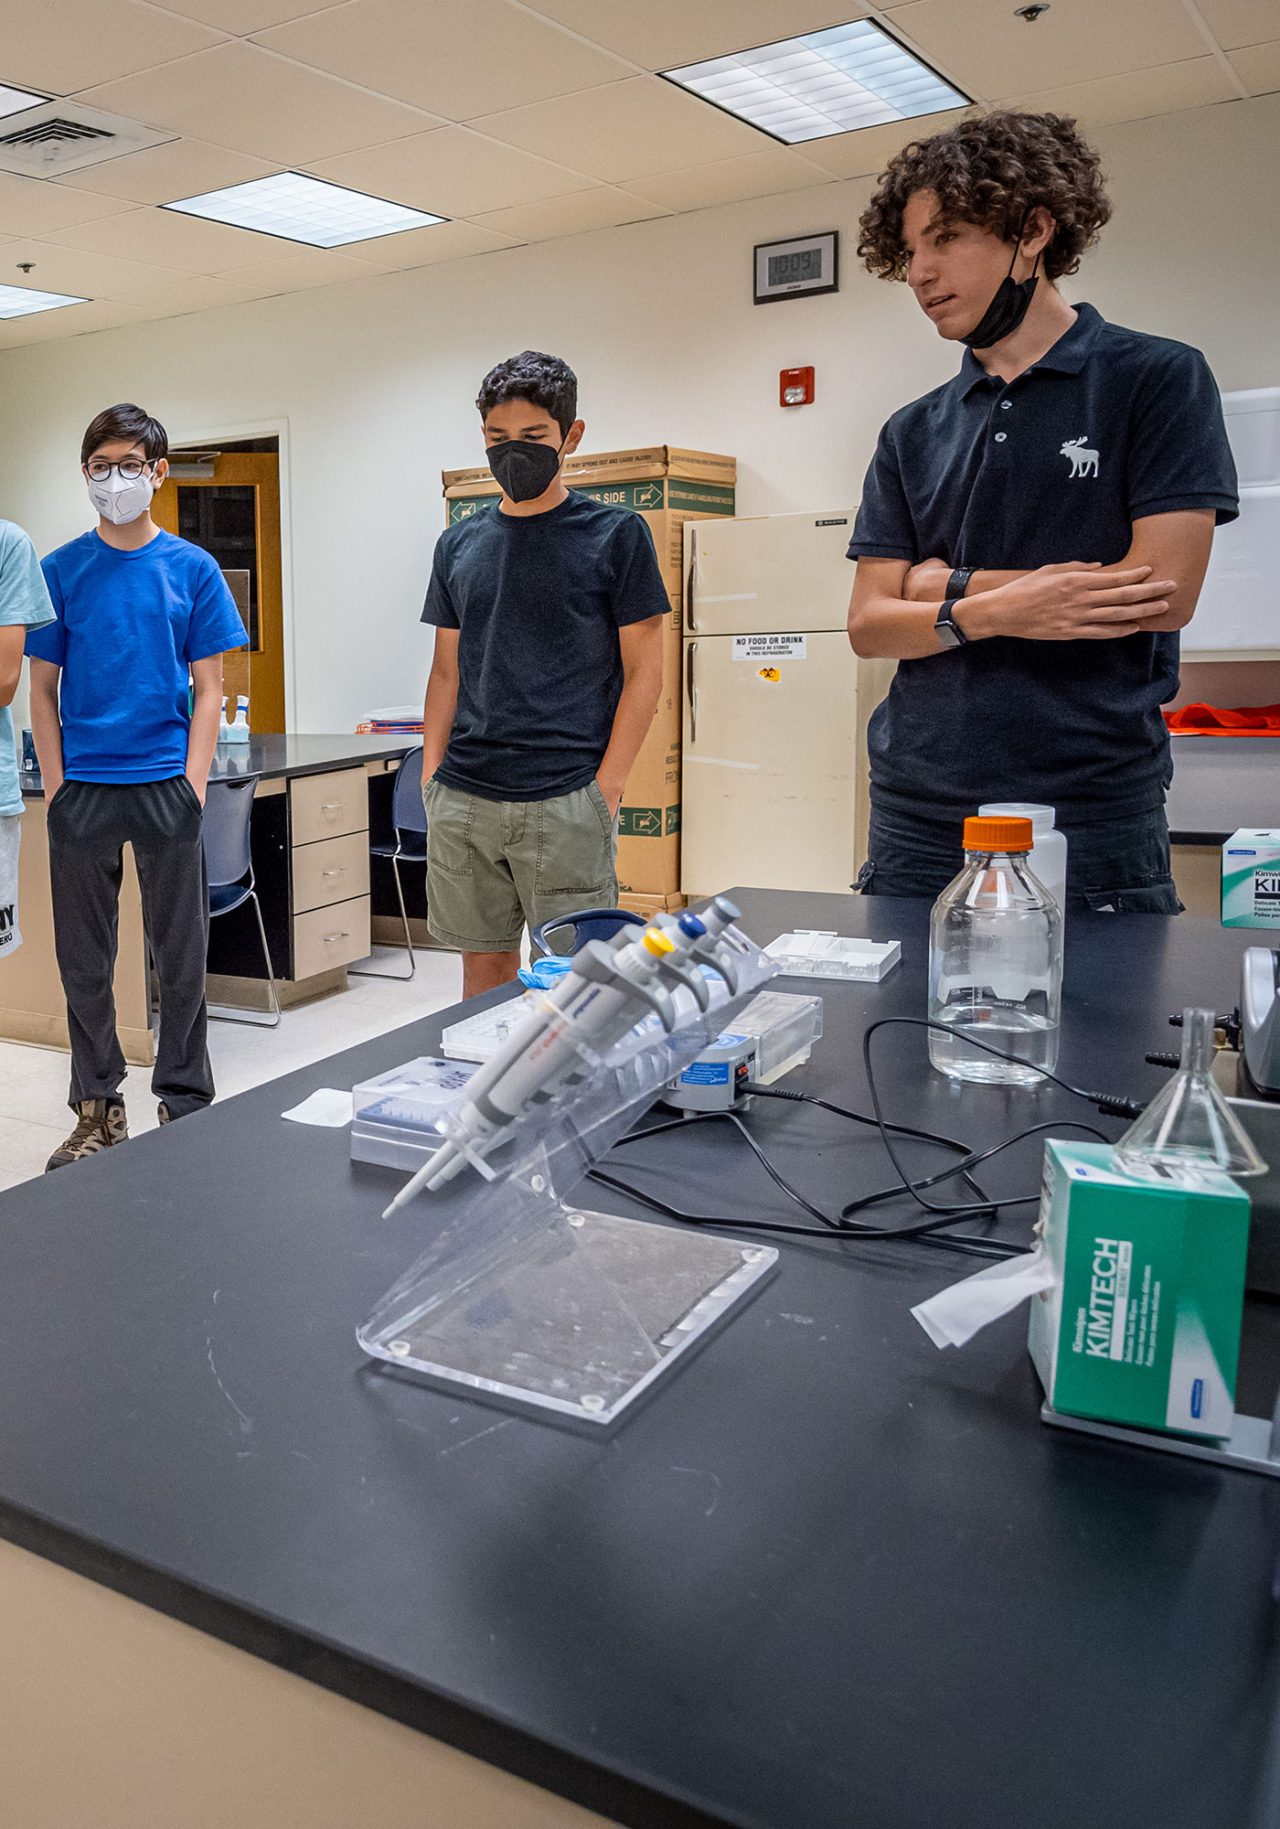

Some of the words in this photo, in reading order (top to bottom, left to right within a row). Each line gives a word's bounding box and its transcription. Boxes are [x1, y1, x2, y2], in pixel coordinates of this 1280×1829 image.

[603, 491, 626, 504] SIDE
[736, 637, 746, 645] NO
[748, 637, 767, 645] FOOD
[769, 636, 779, 645] OR
[781, 635, 803, 644] DRINK
[1086, 1237, 1119, 1358] KIMTECH
